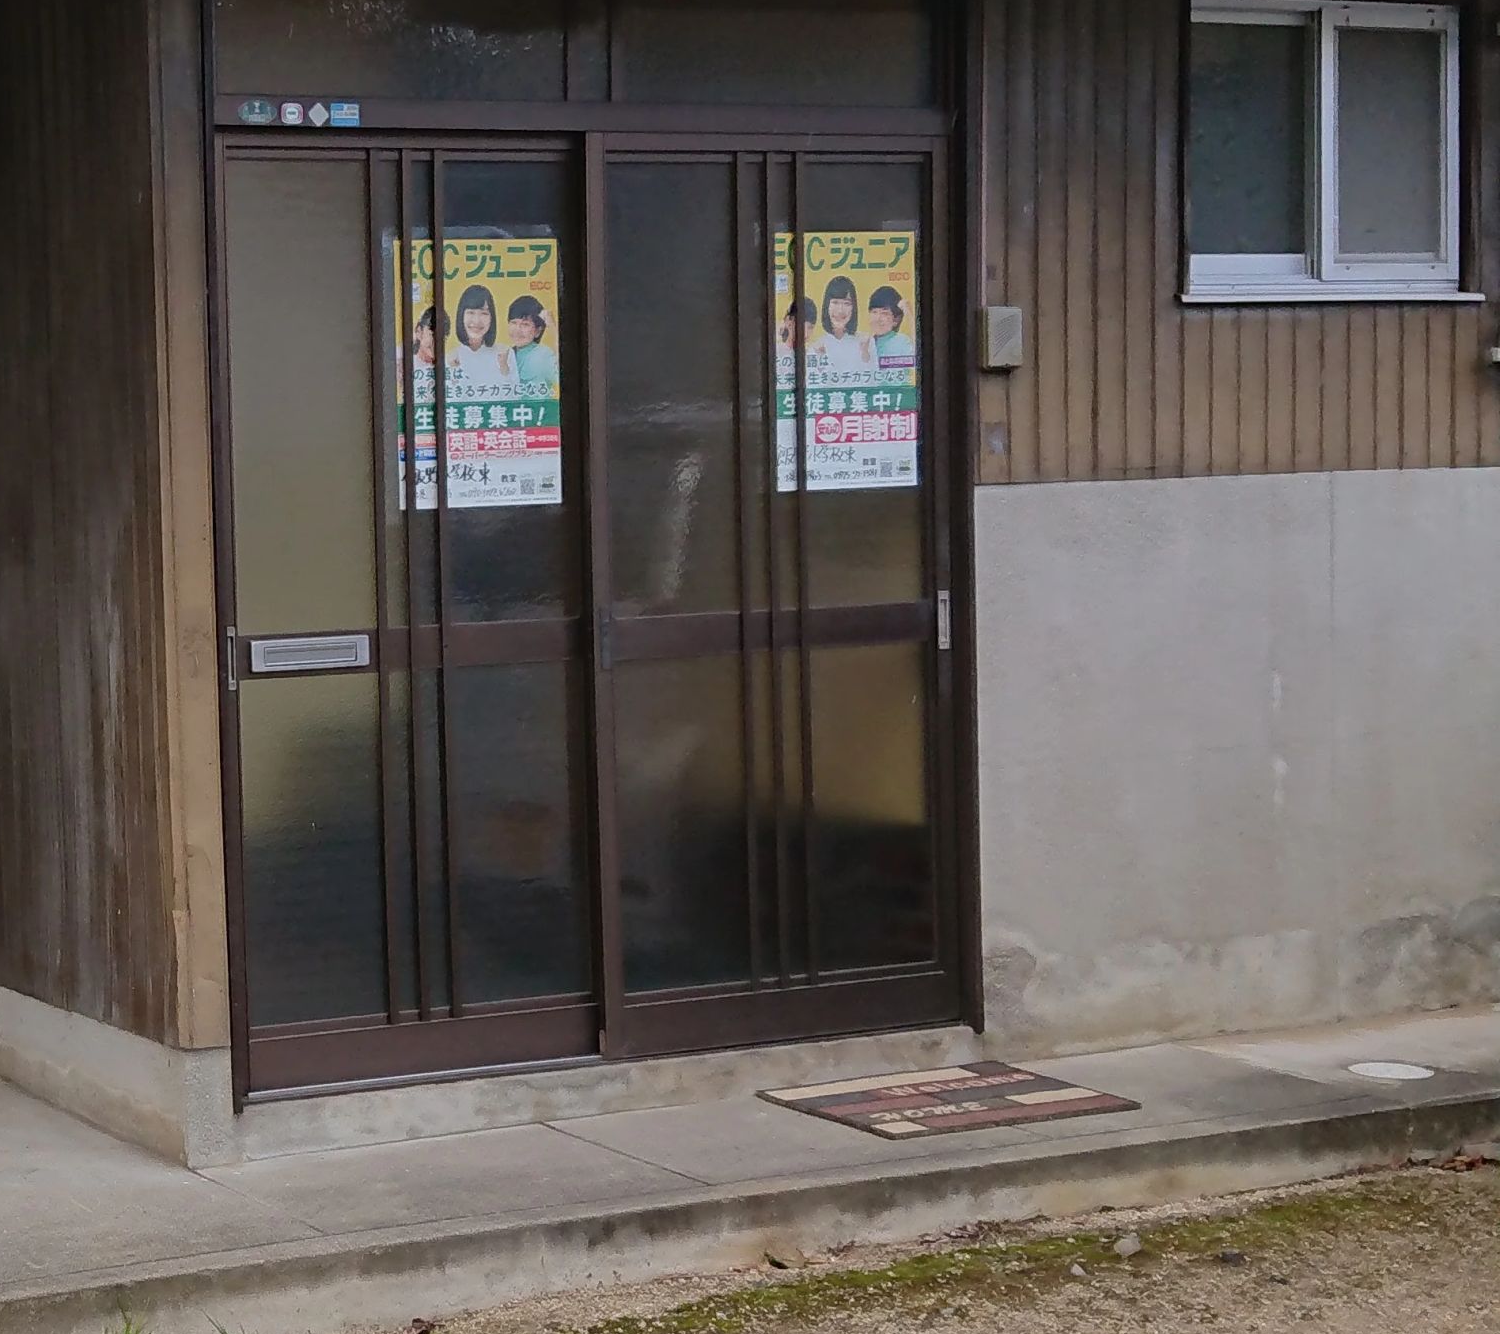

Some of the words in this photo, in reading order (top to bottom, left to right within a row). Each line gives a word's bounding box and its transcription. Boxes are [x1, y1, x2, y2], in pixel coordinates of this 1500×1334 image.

[841, 413, 917, 442] 月謝制
[449, 430, 527, 452] 英語・英会話
[880, 1073, 1036, 1098] Welcome
